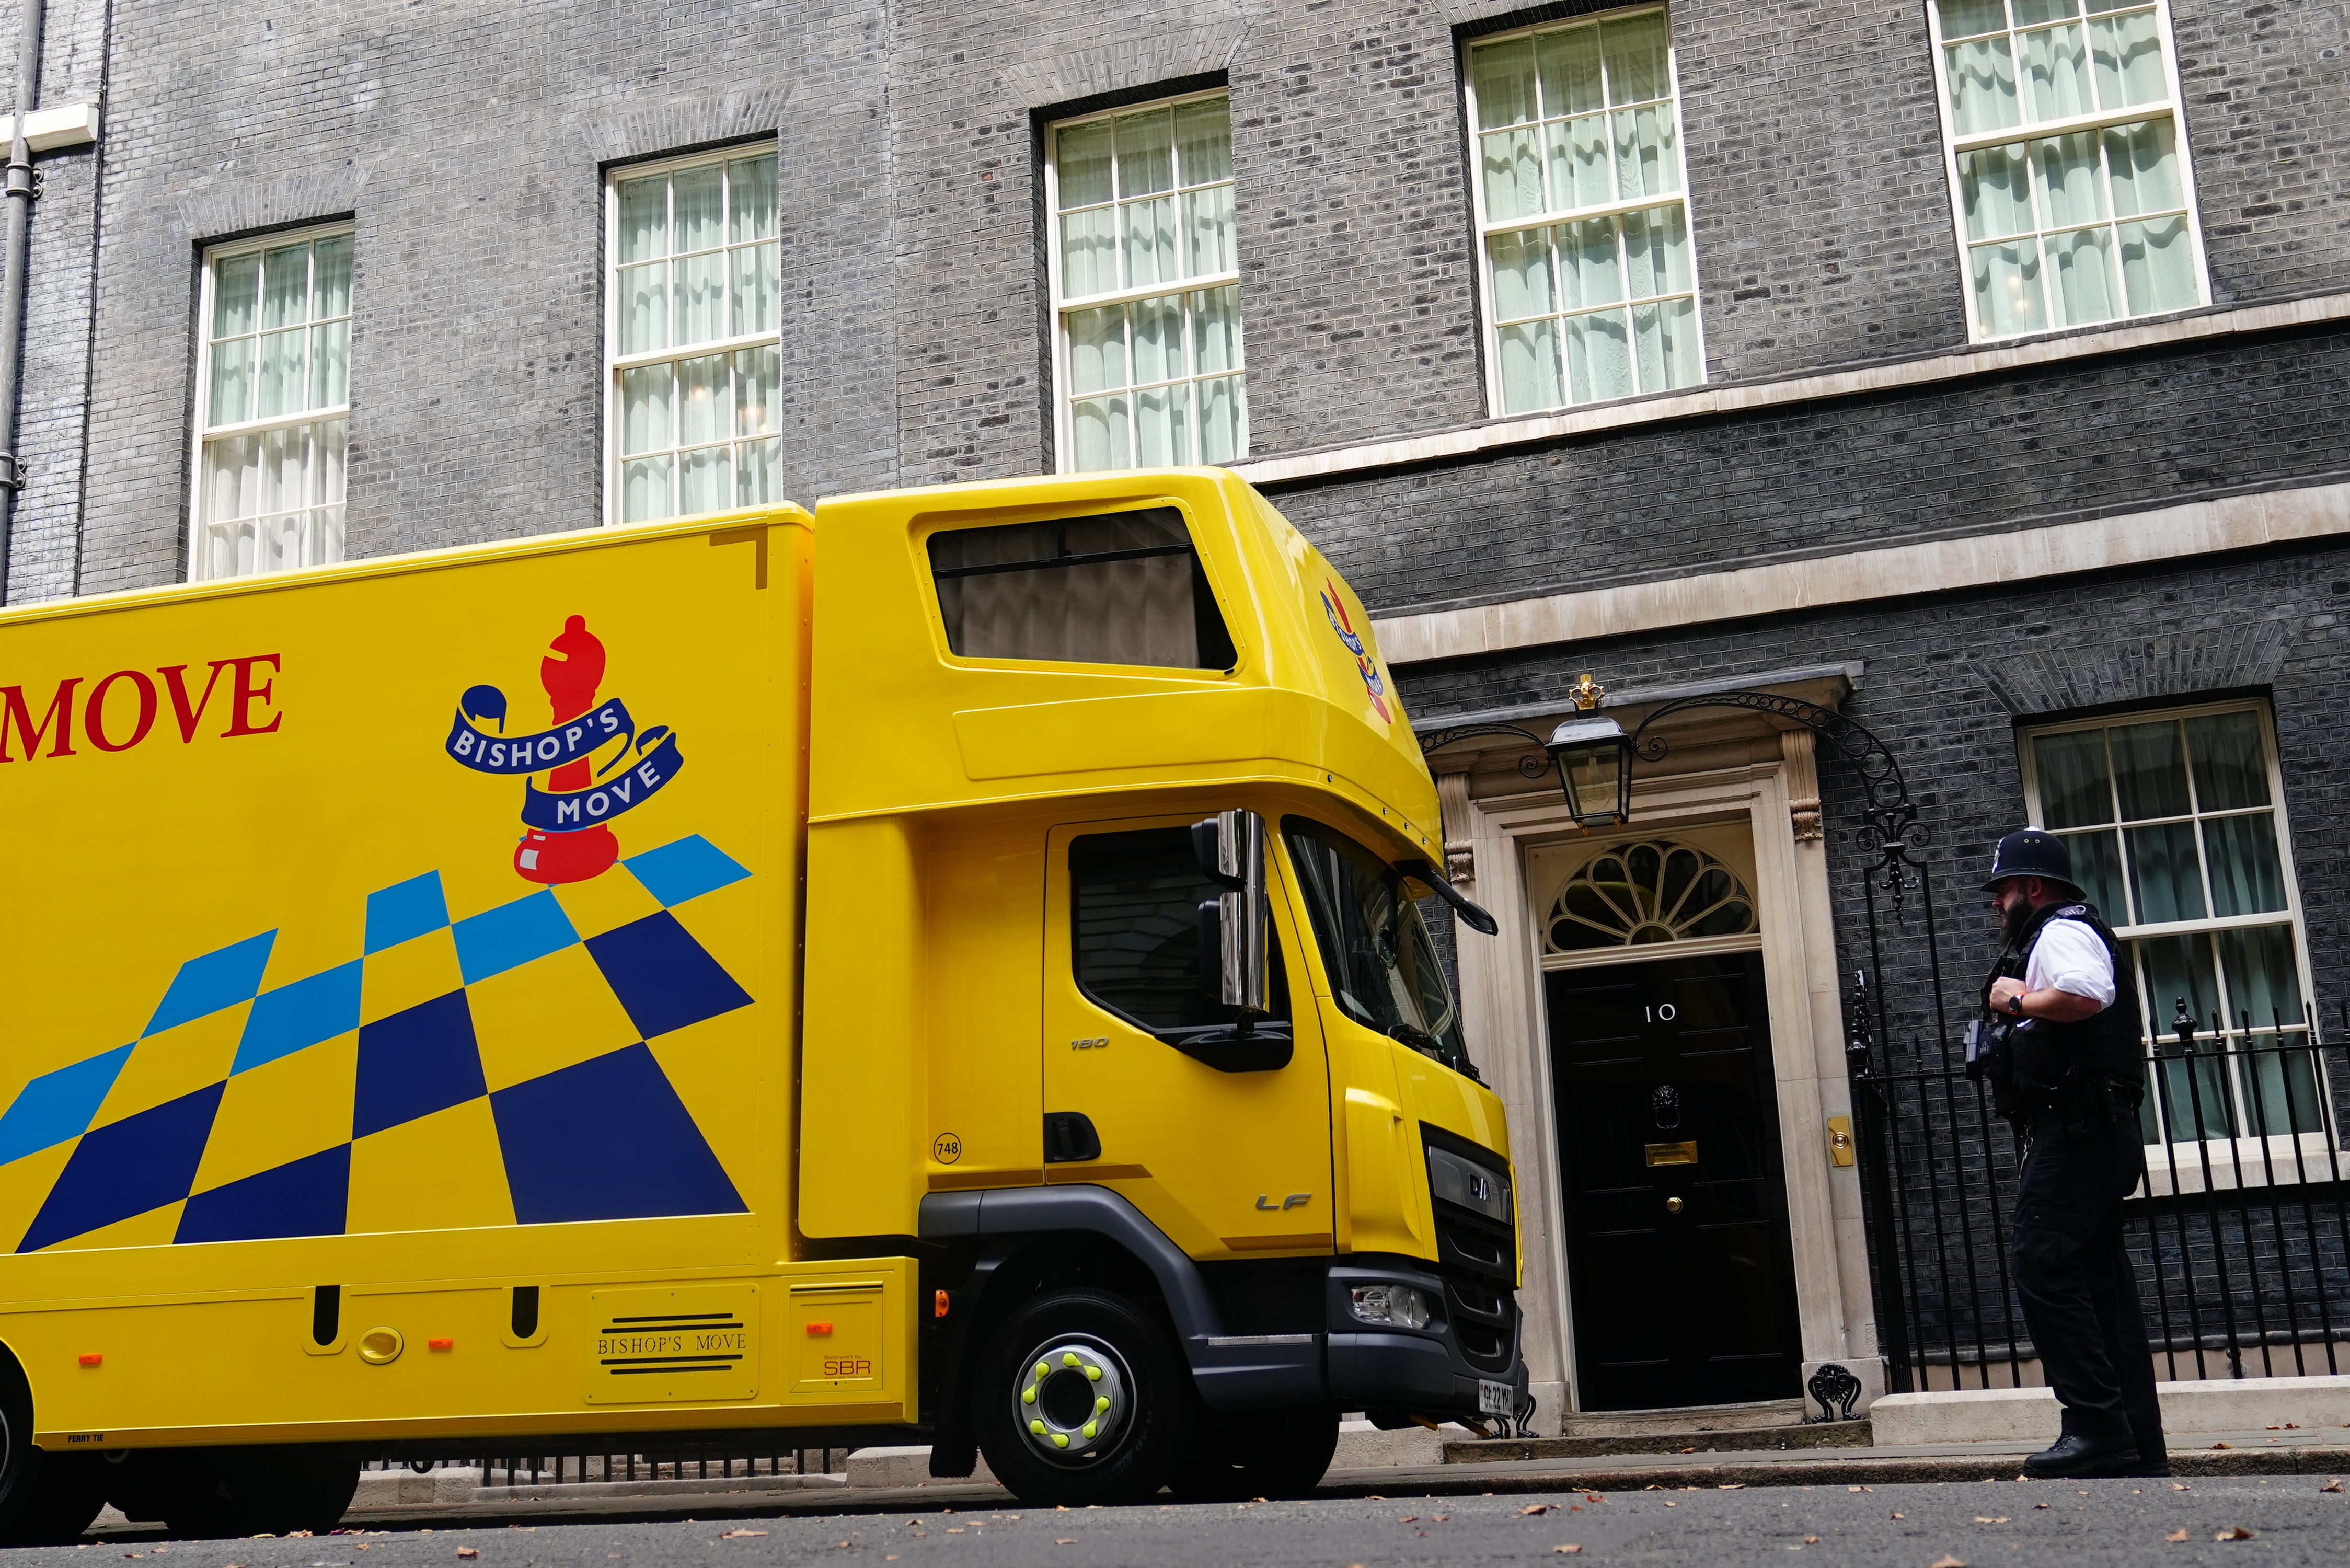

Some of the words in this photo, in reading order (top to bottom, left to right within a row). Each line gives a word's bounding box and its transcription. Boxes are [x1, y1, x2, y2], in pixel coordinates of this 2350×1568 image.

[0, 653, 283, 764] MOVE
[453, 708, 619, 767] BISHOP'S
[557, 760, 661, 824] MOVE
[1646, 1004, 1676, 1022] 10
[1070, 1037, 1109, 1050] 180
[937, 1142, 958, 1155] 748
[1255, 1193, 1311, 1210] LF
[597, 1335, 682, 1355] BISHOP'S
[696, 1333, 746, 1351] MOVE
[824, 1360, 871, 1376] SBR
[68, 1434, 91, 1443] FERRY
[93, 1434, 104, 1442] TIE
